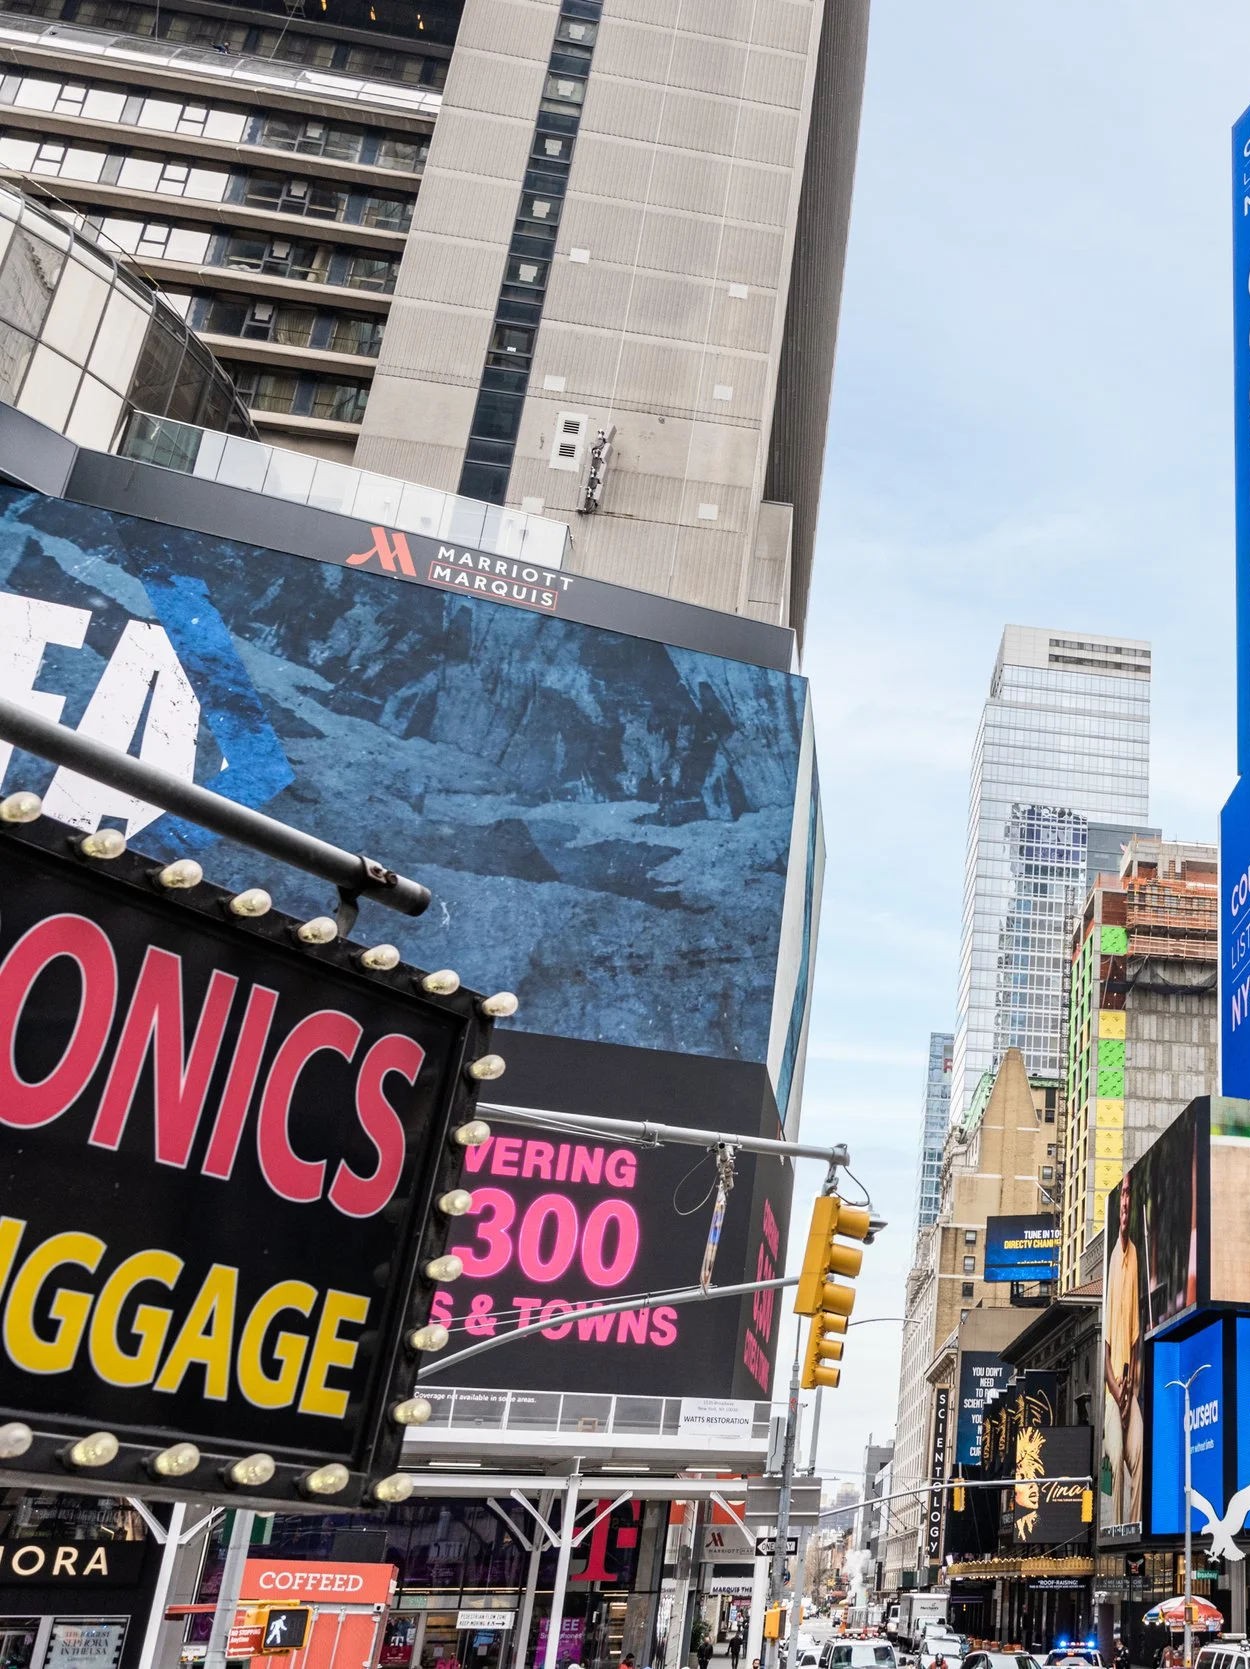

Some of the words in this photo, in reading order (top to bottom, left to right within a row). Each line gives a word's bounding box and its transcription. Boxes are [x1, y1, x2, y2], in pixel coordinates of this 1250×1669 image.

[436, 545, 574, 591] MARRIOTT
[433, 564, 556, 608] MARQUIS
[464, 1137, 637, 1188] VERING
[1024, 1230, 1042, 1239] TUNE
[1042, 1230, 1050, 1239] IN
[1004, 1240, 1033, 1249] DIRECTV
[464, 1296, 496, 1336] &
[512, 1297, 678, 1347] TOWNS
[972, 1367, 985, 1377] YOU
[985, 1367, 1003, 1377] DON'T
[980, 1378, 994, 1387] NEED
[414, 1391, 446, 1400] Coverage
[459, 1393, 489, 1401] available
[517, 1396, 537, 1404] areas.
[976, 1388, 983, 1397] TO
[706, 1416, 750, 1425] RESTORATION
[930, 1393, 947, 1553] SCIENTOLOGY
[1041, 1481, 1085, 1504] Tina
[761, 1542, 774, 1552] ONE
[0, 1545, 109, 1576] ORA
[259, 1571, 363, 1592] COFFEED
[712, 1586, 740, 1594] MARQUIS
[61, 1638, 109, 1648] SEPHORA
